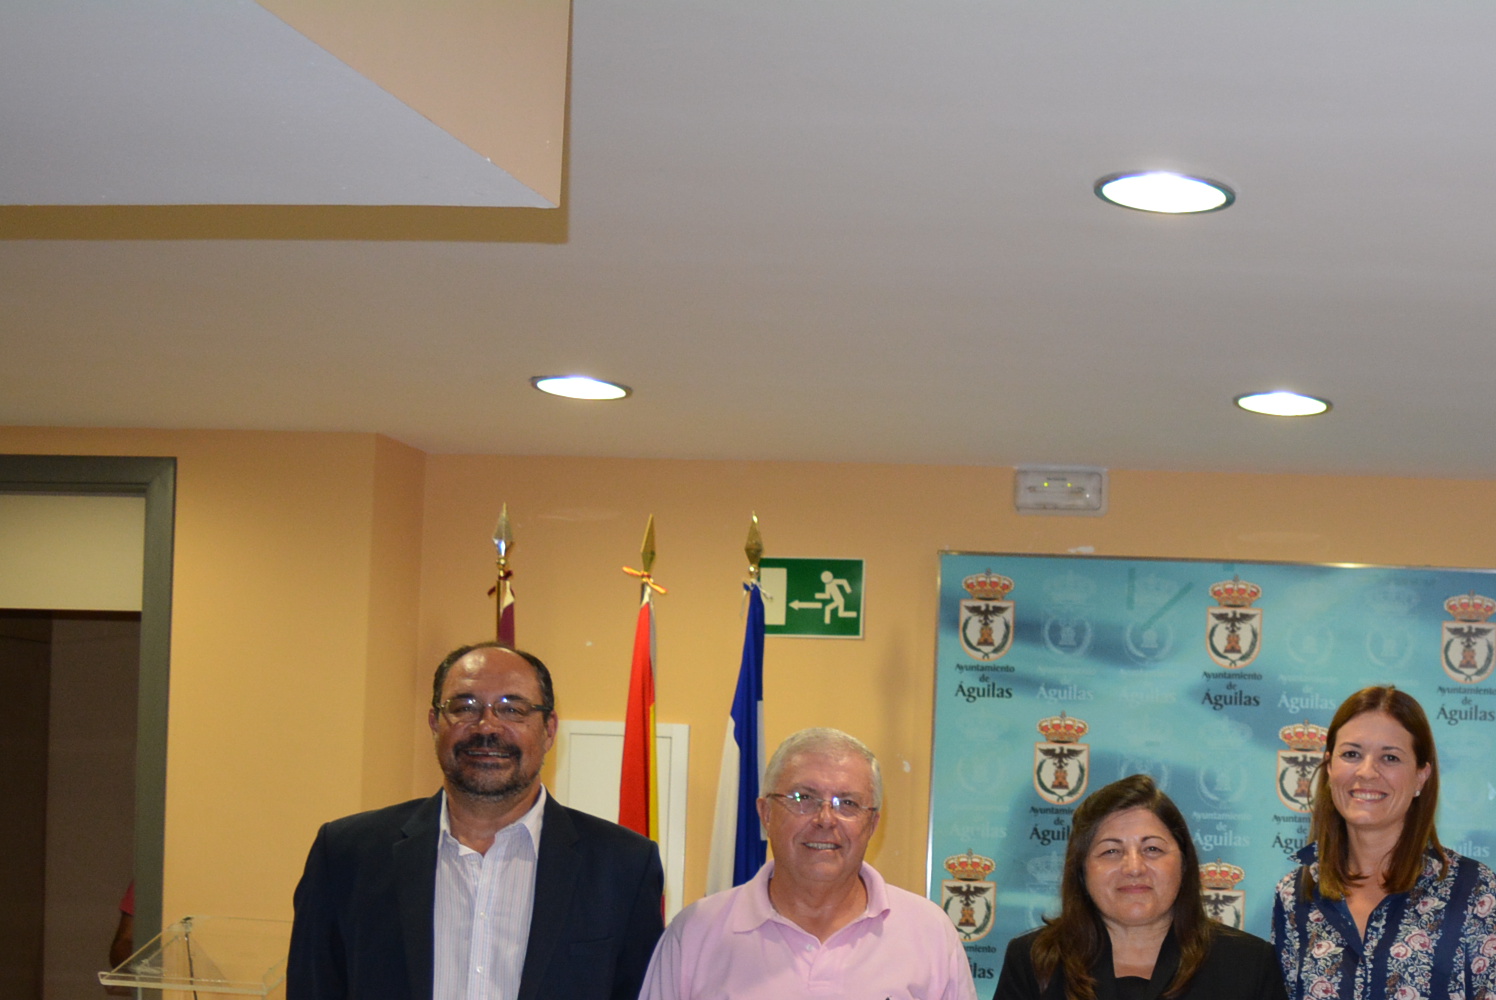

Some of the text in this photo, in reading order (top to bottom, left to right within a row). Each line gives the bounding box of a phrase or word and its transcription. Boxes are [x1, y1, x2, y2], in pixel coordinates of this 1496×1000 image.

[955, 663, 1015, 674] Ayuntamiento
[979, 674, 990, 683] de
[1202, 672, 1262, 681] Ayuntamiento
[1227, 681, 1237, 690] de
[955, 683, 1012, 702] Águilas
[1436, 686, 1496, 696] Ayuntamiento
[1201, 690, 1261, 710] Águilas
[1462, 696, 1472, 705] de
[1436, 705, 1495, 725] Águilas
[1053, 816, 1066, 825] de
[1297, 825, 1307, 834] de
[1029, 823, 1071, 846] Águil
